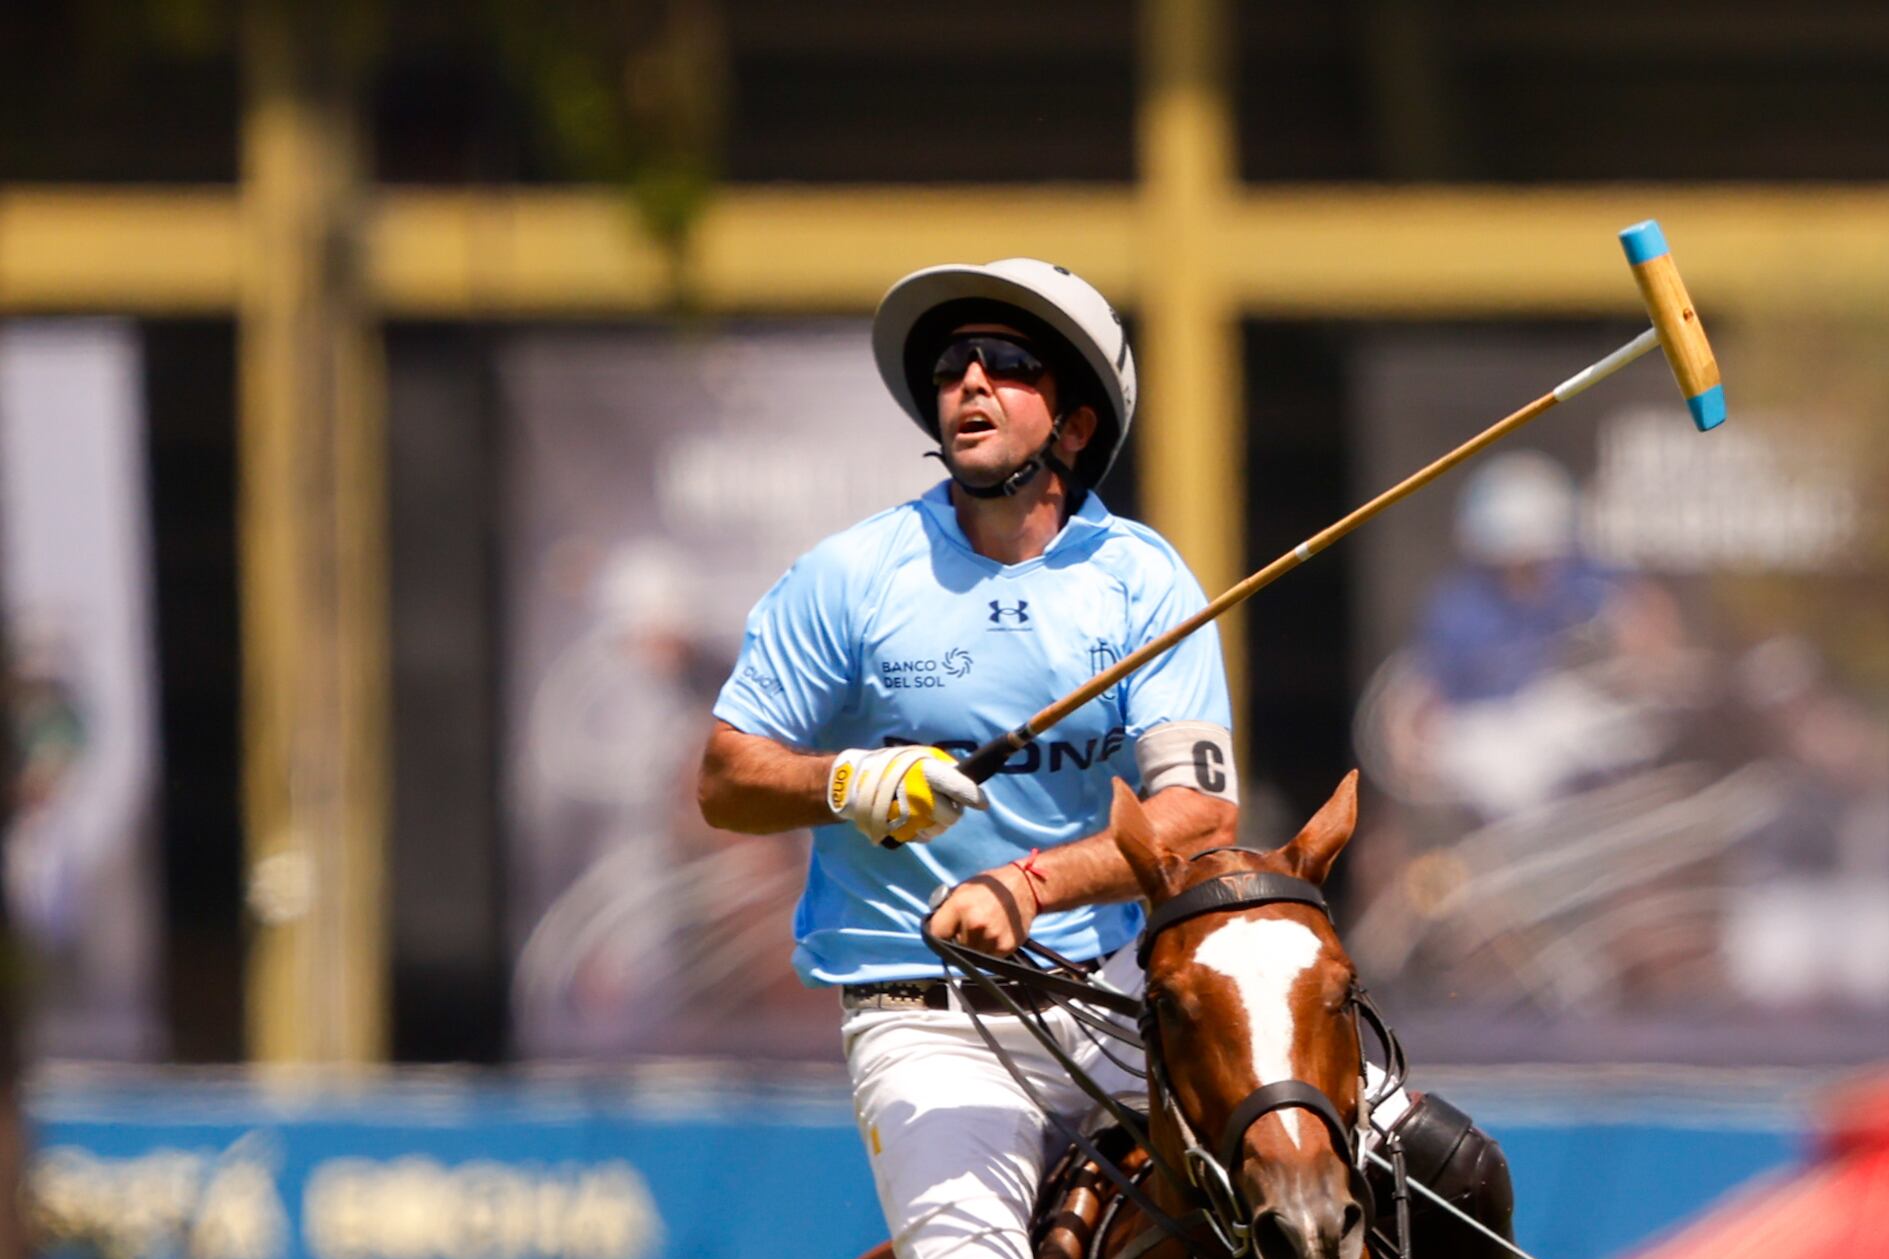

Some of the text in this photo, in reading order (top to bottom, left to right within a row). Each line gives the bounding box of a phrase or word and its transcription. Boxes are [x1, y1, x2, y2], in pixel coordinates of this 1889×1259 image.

[881, 659, 937, 673] BANCO
[884, 675, 946, 689] DEL SOL
[1192, 740, 1226, 793] C
